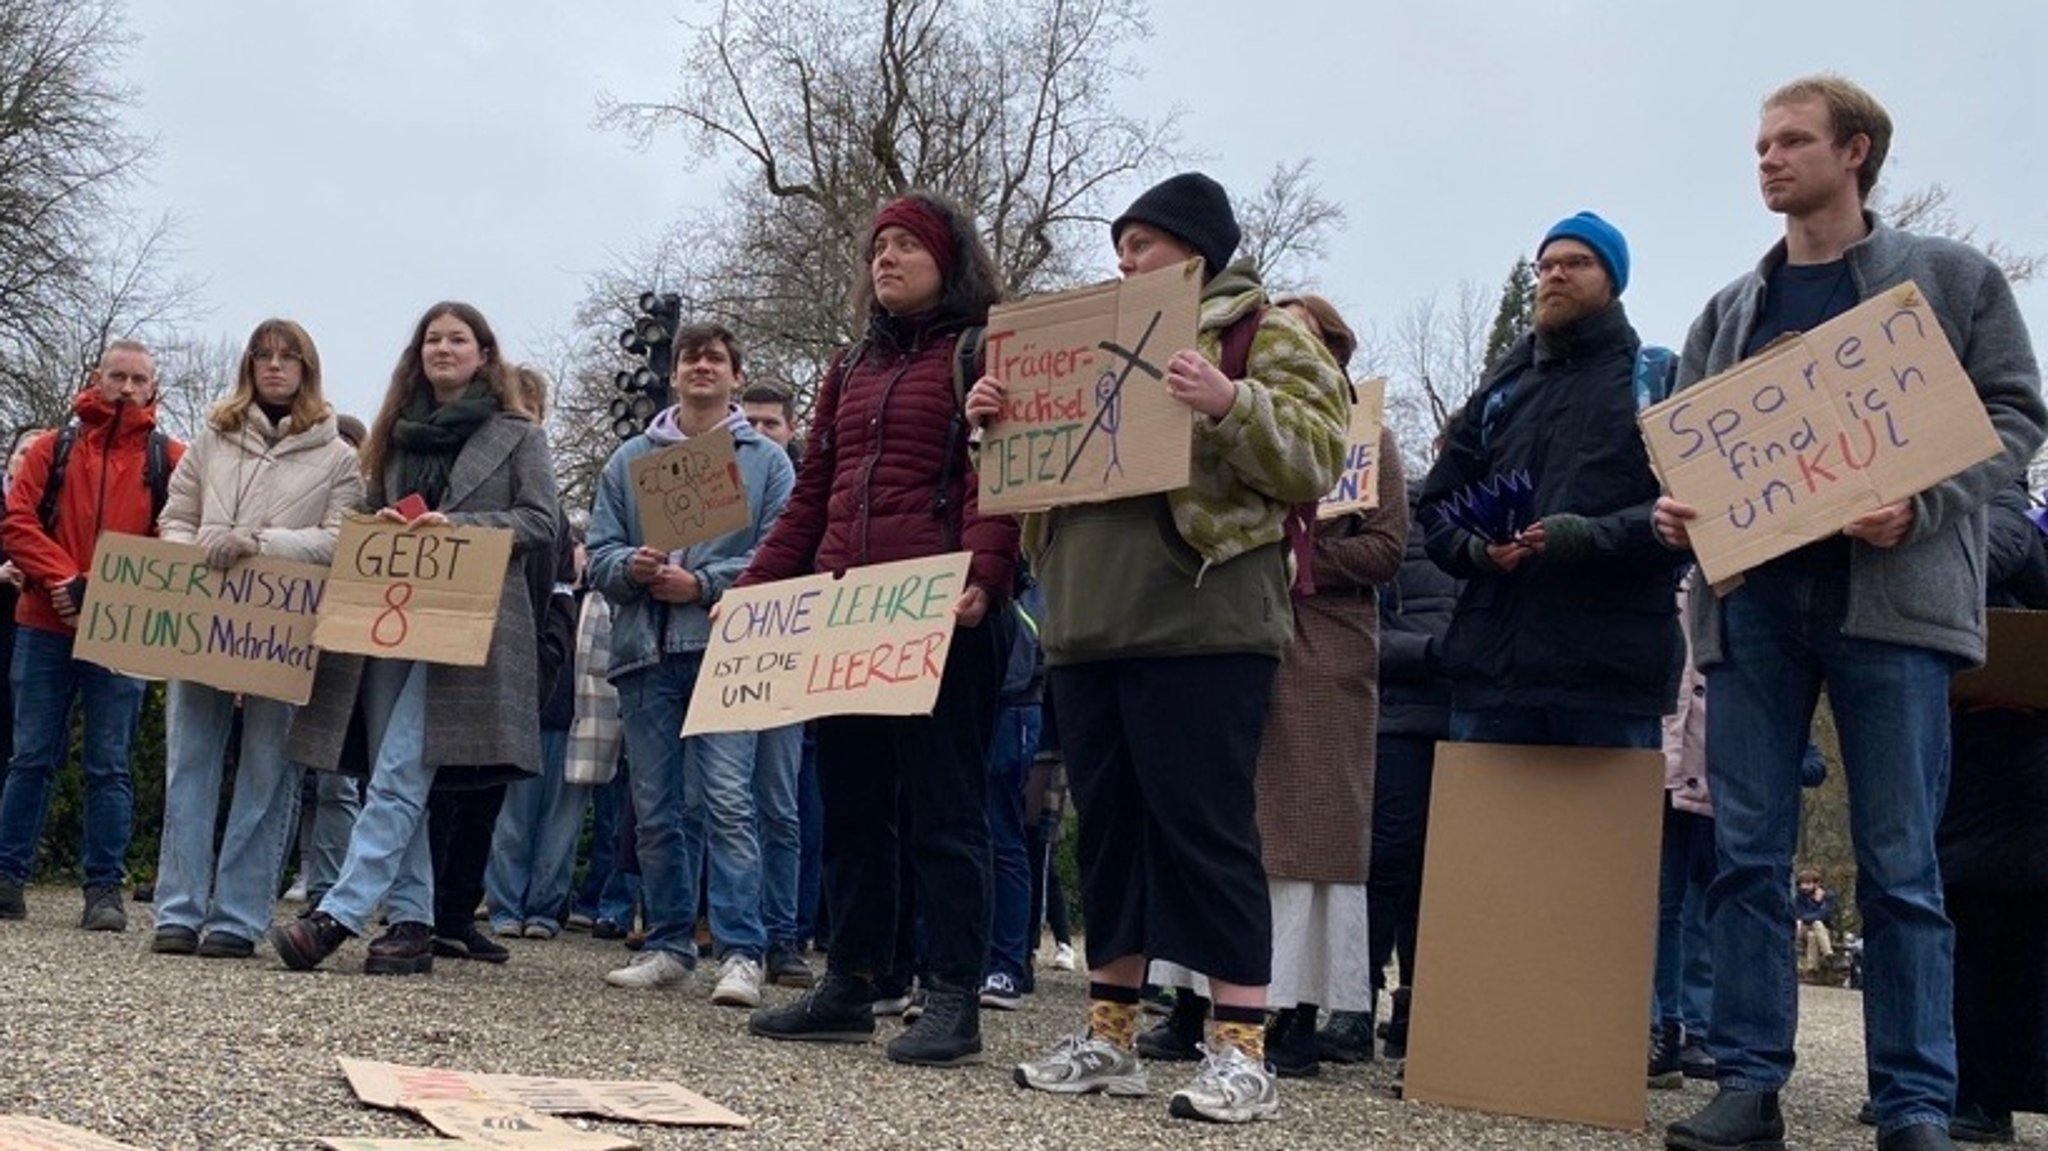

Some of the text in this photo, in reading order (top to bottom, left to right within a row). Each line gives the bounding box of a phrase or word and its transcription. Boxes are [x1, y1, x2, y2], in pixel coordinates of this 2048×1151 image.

[987, 329, 1094, 394] Träger-
[1668, 308, 1926, 459] Sparen
[1729, 364, 1926, 480] find ich
[987, 422, 1084, 495] JETZT
[101, 553, 325, 616] UNSER WISSEN
[356, 531, 471, 580] GEBT
[87, 602, 141, 643] IST
[141, 607, 204, 656] UNS
[370, 581, 412, 648] 8
[721, 571, 957, 644] OHNE LEHRE
[714, 632, 946, 697] IST DIE LEERER
[721, 682, 772, 709] UNI
